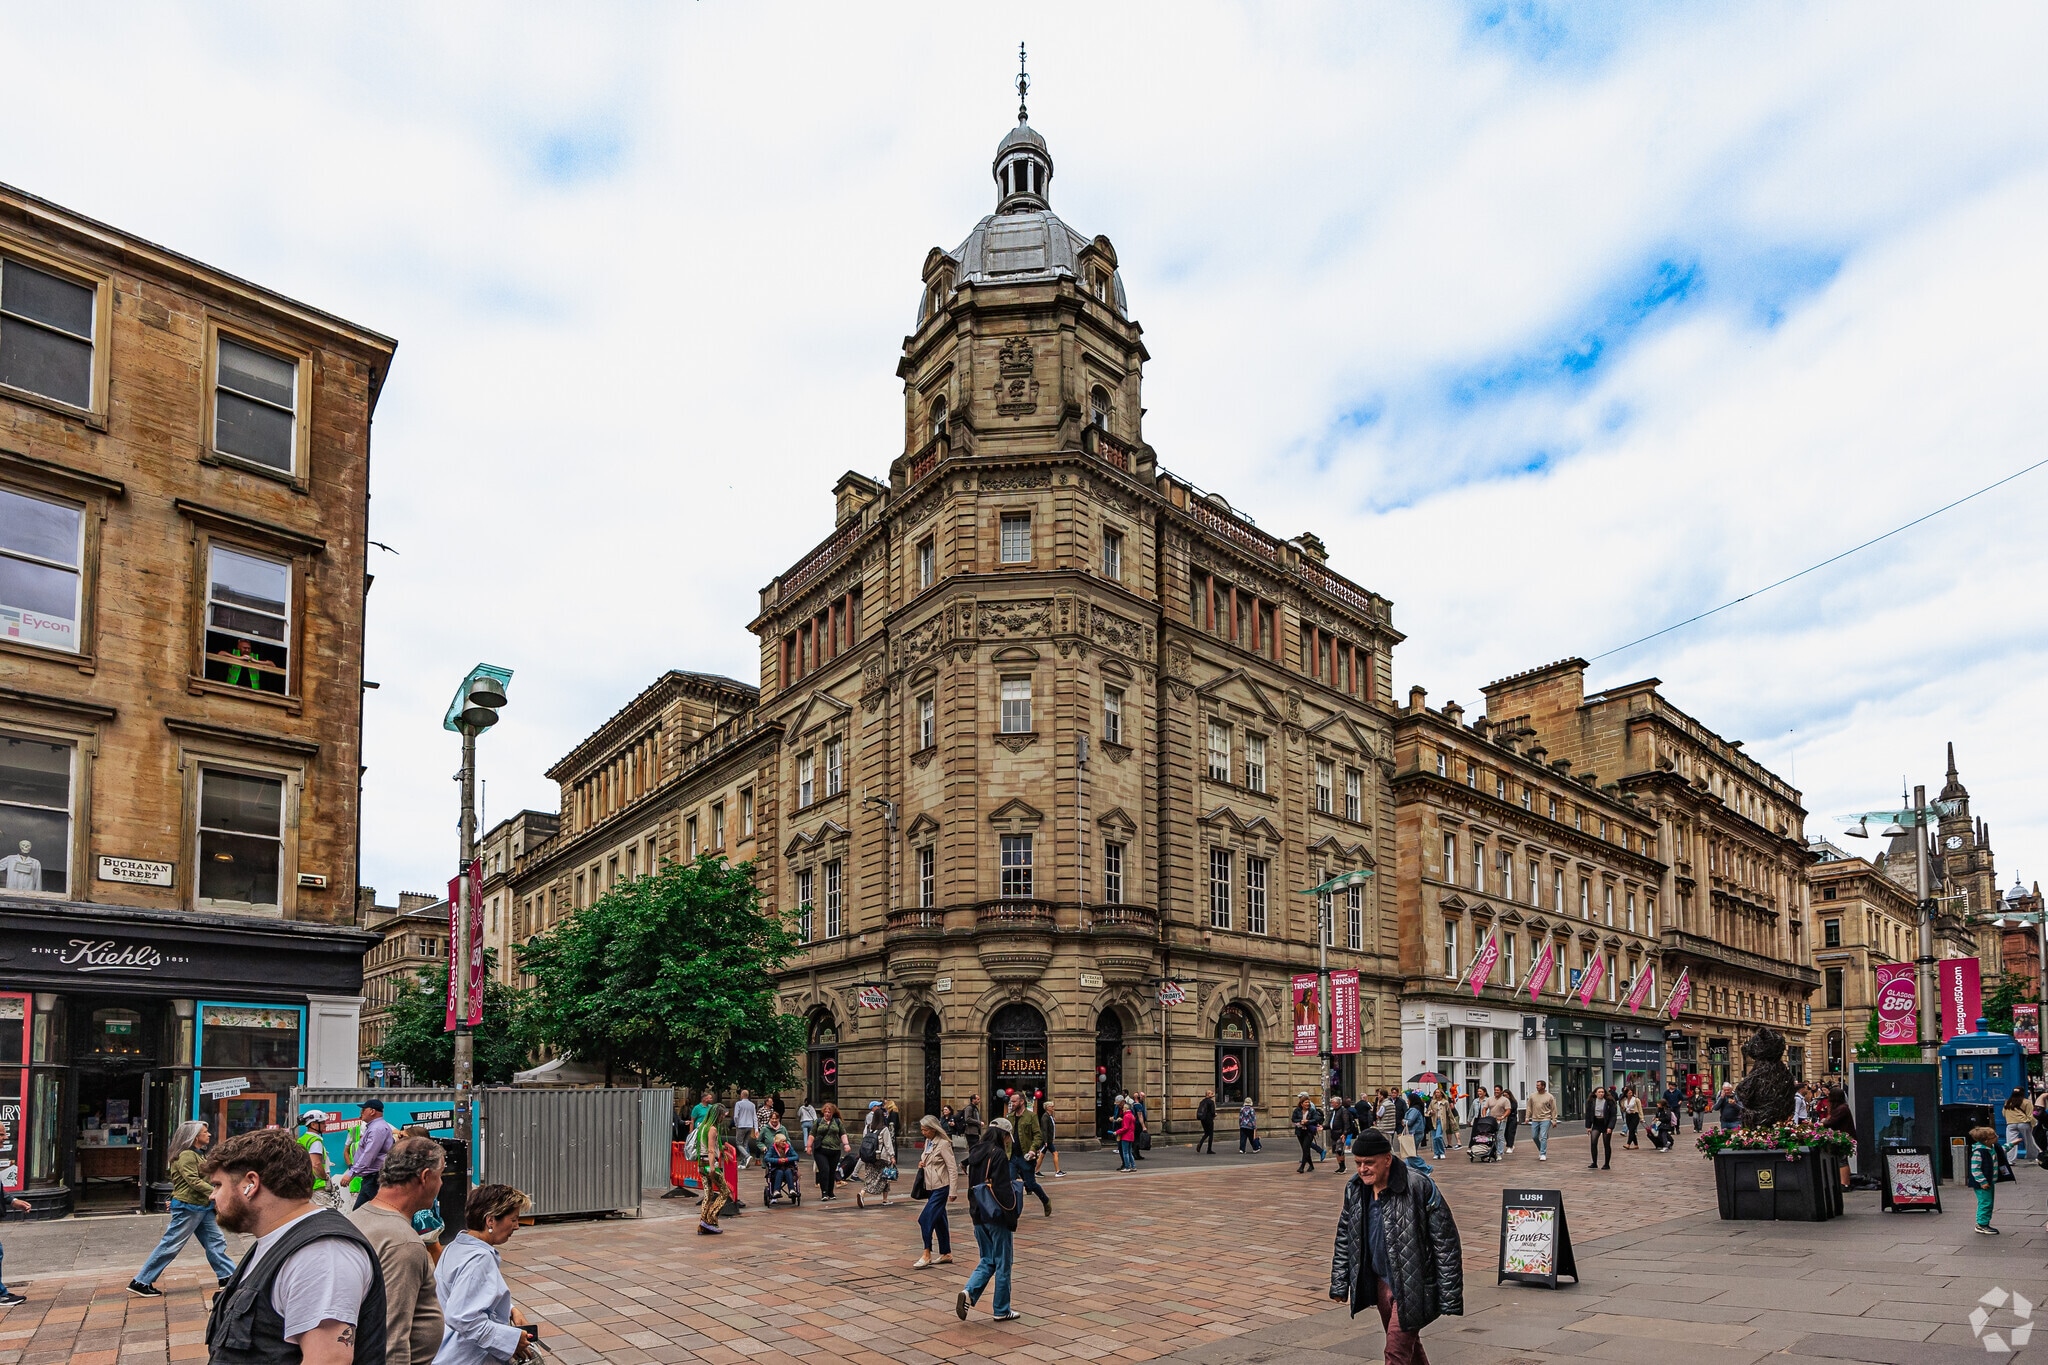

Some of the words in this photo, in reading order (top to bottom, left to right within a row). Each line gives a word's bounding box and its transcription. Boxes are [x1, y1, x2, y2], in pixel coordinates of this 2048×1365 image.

[22, 613, 70, 633] Eycon
[103, 858, 168, 872] BUCHANAN
[112, 867, 159, 879] STREET
[31, 947, 67, 955] SINCE
[60, 939, 161, 967] Kiehl's
[1332, 977, 1357, 985] TRNSMT
[1336, 987, 1344, 1016] SMITH
[1882, 996, 1913, 1010] 850
[1954, 966, 1967, 1035] glasgow850.com
[1336, 1018, 1344, 1048] MYLES
[417, 1112, 432, 1120] HELPS
[1509, 1232, 1551, 1242] FLOWERS
